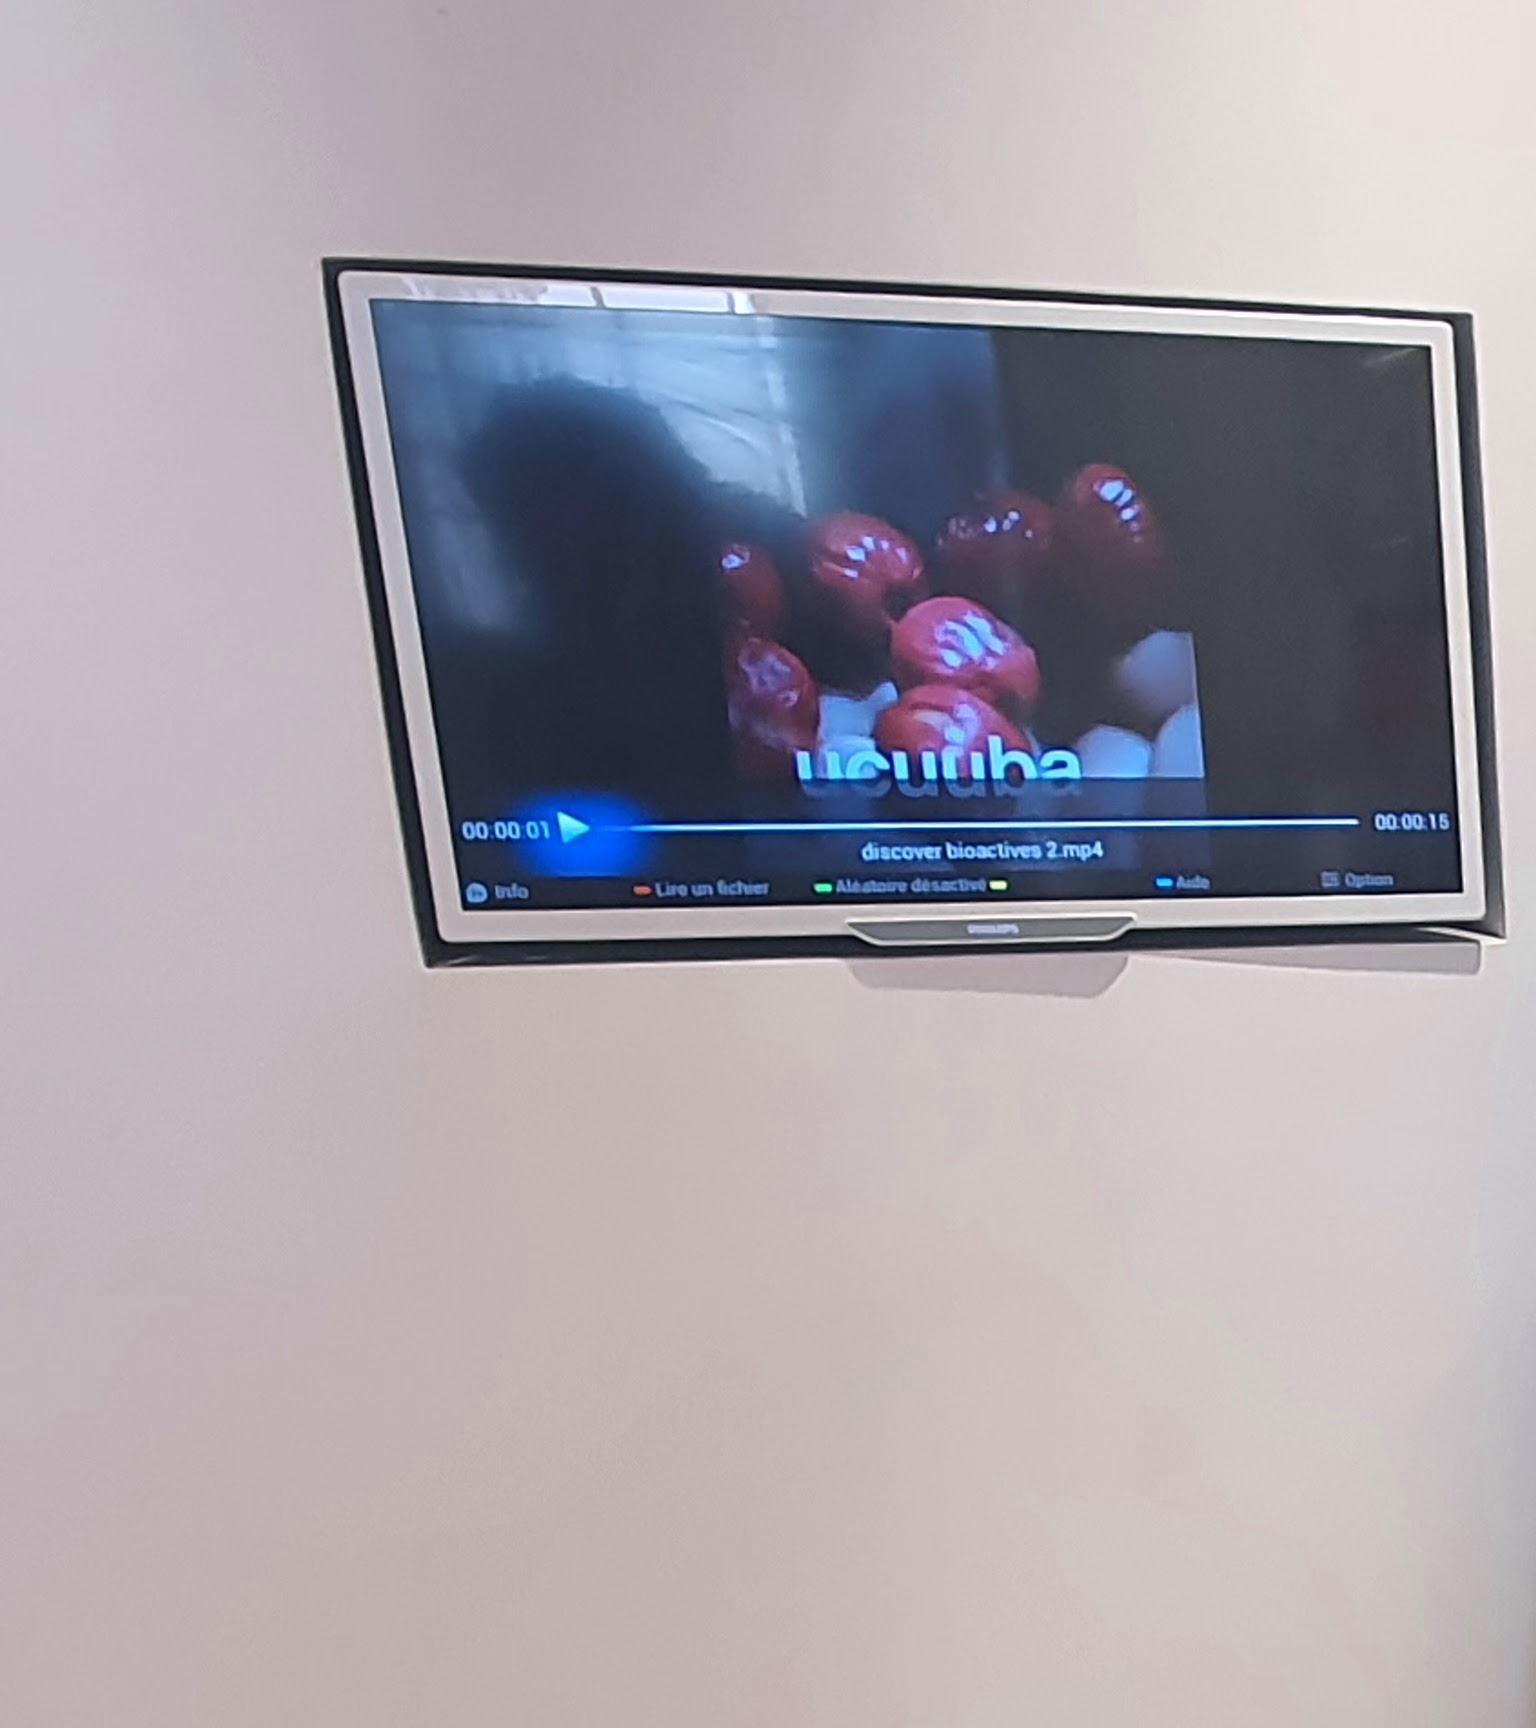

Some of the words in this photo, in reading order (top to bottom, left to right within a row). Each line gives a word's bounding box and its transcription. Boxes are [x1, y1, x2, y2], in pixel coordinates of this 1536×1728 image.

[461, 821, 550, 840] 00:00:01
[1373, 812, 1450, 831] 00:00:15
[861, 842, 942, 860] discover
[945, 841, 1042, 860] bioactives
[1046, 841, 1104, 862] 2.mp4
[494, 883, 529, 898] Info
[655, 881, 688, 897] Lire
